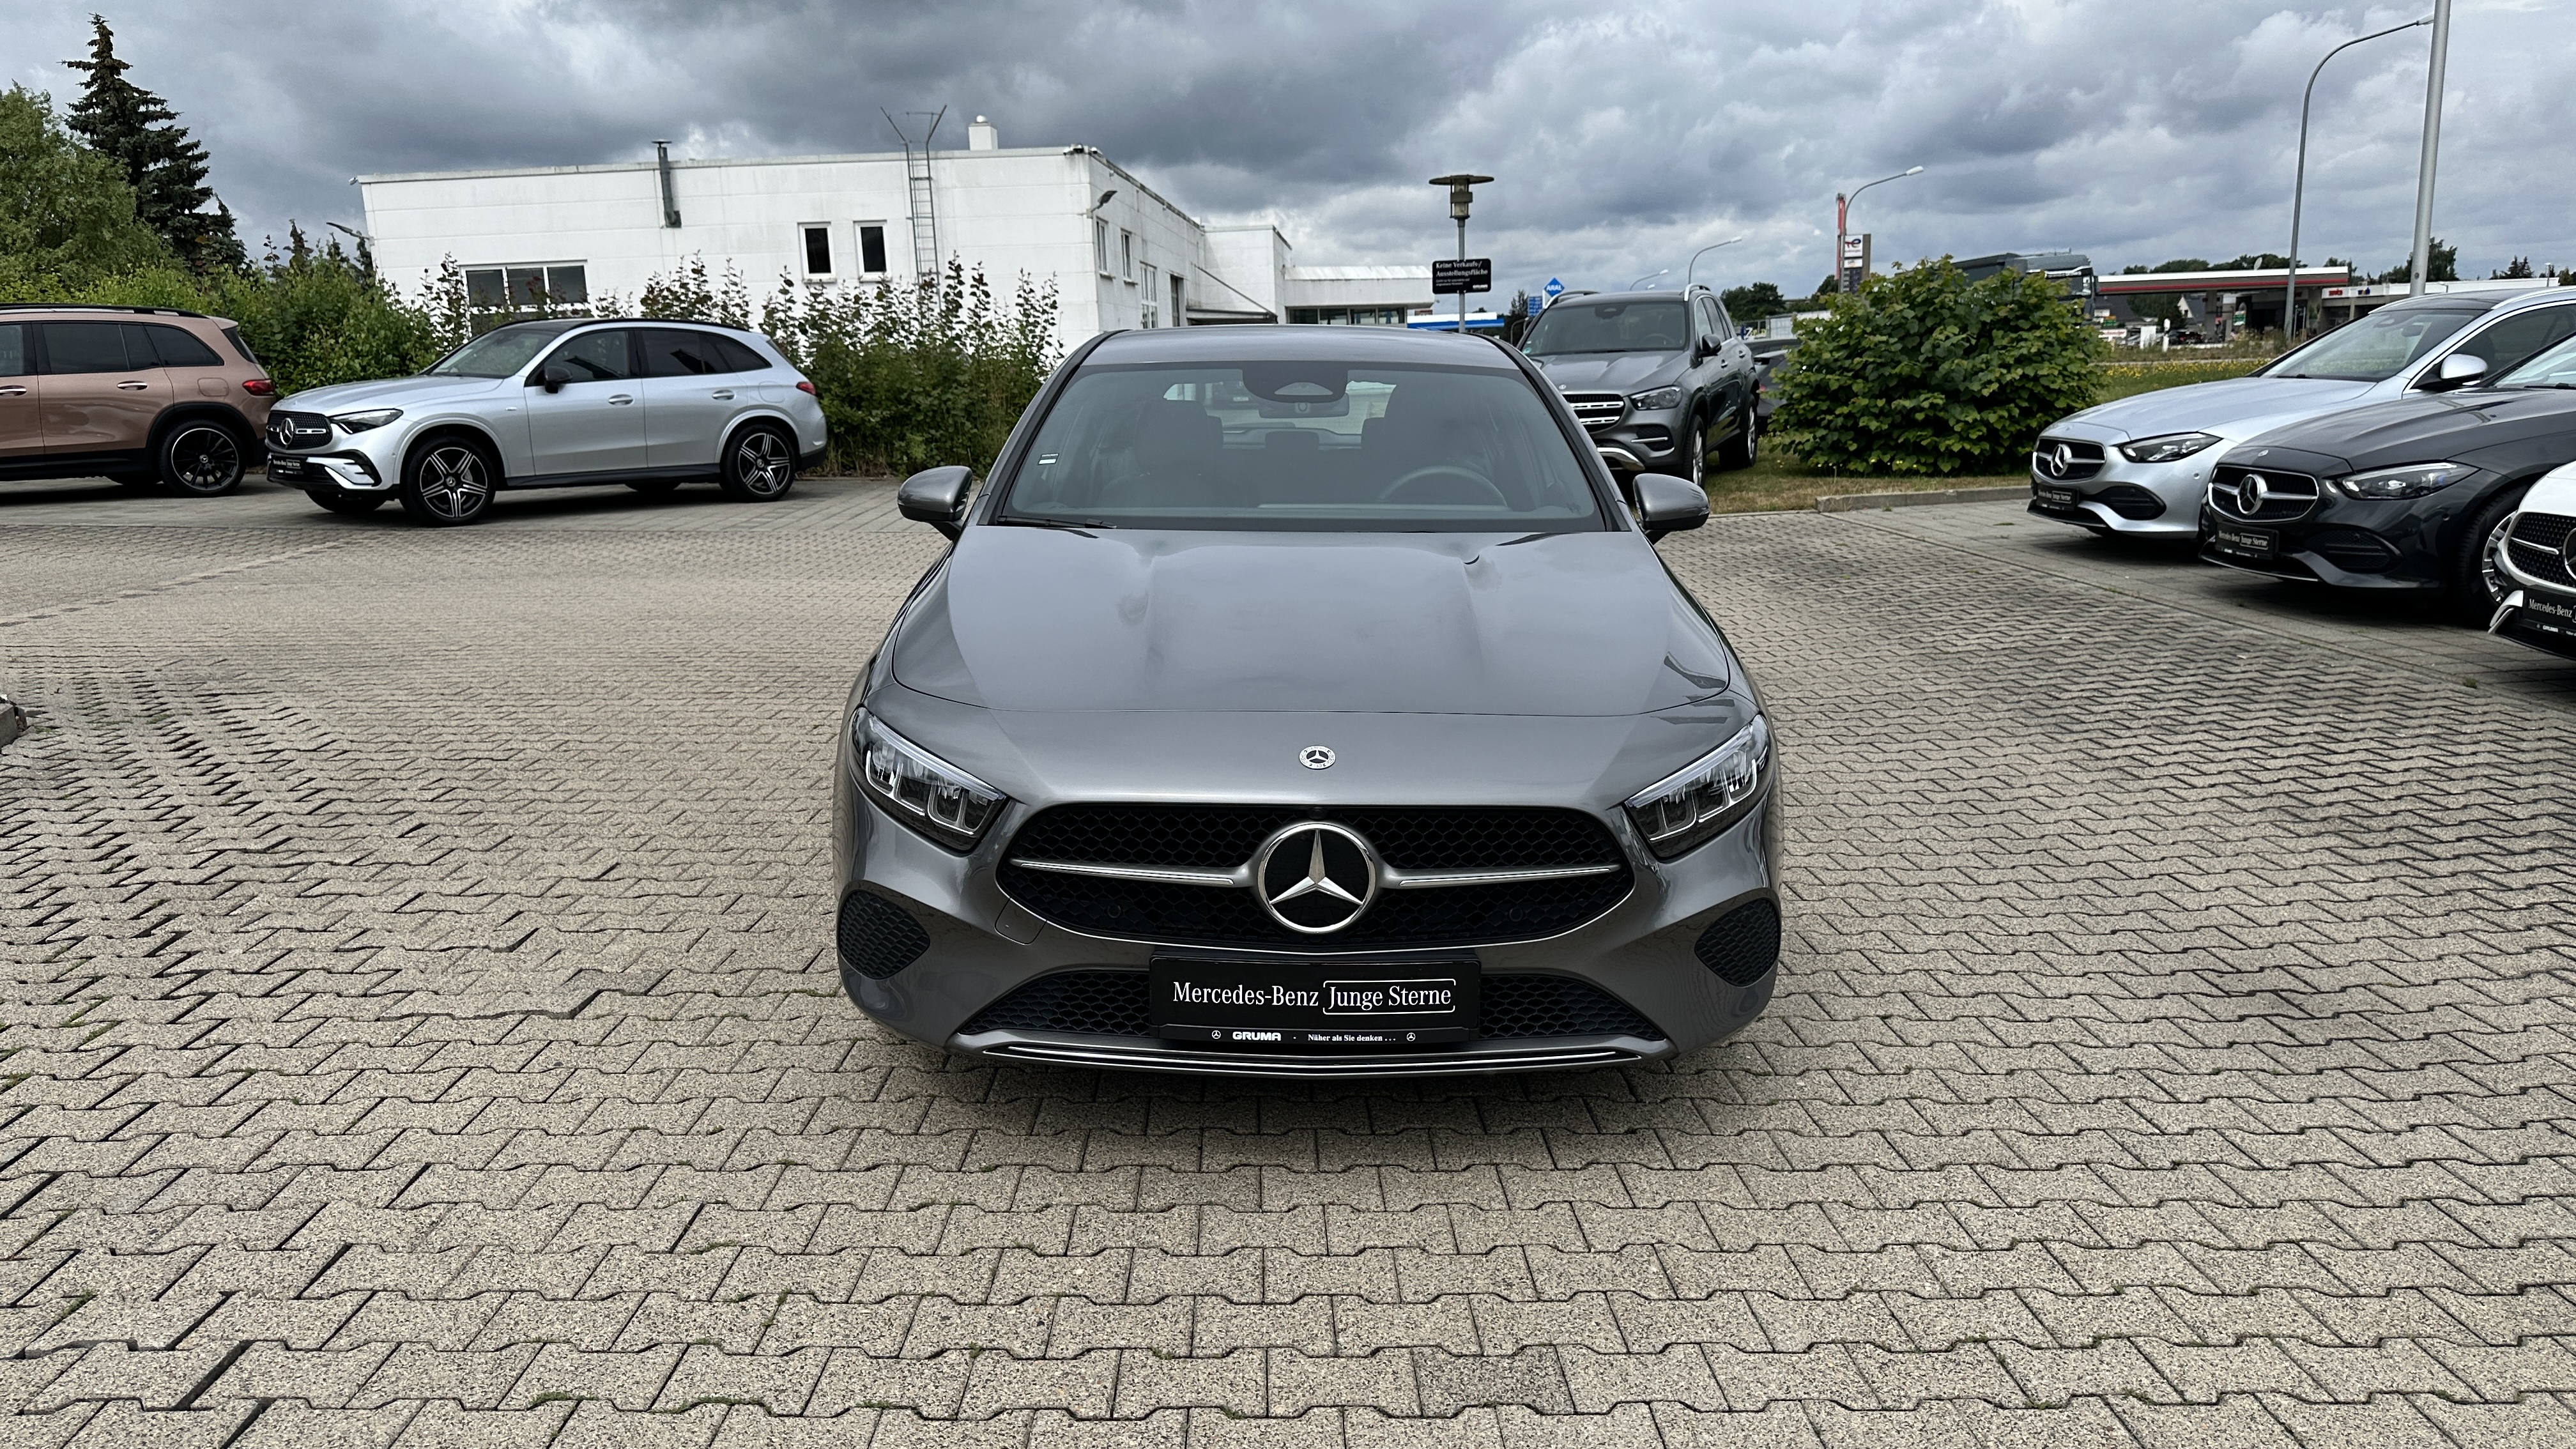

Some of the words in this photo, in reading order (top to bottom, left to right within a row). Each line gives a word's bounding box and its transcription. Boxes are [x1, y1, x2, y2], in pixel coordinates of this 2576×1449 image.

[2528, 598, 2573, 618] Mercedes-Benz
[1172, 981, 1319, 1006] Mercedes-Benz
[1328, 986, 1383, 1011] Junge
[1388, 985, 1451, 1006] Sterne
[1232, 1031, 1282, 1041] GRUMA
